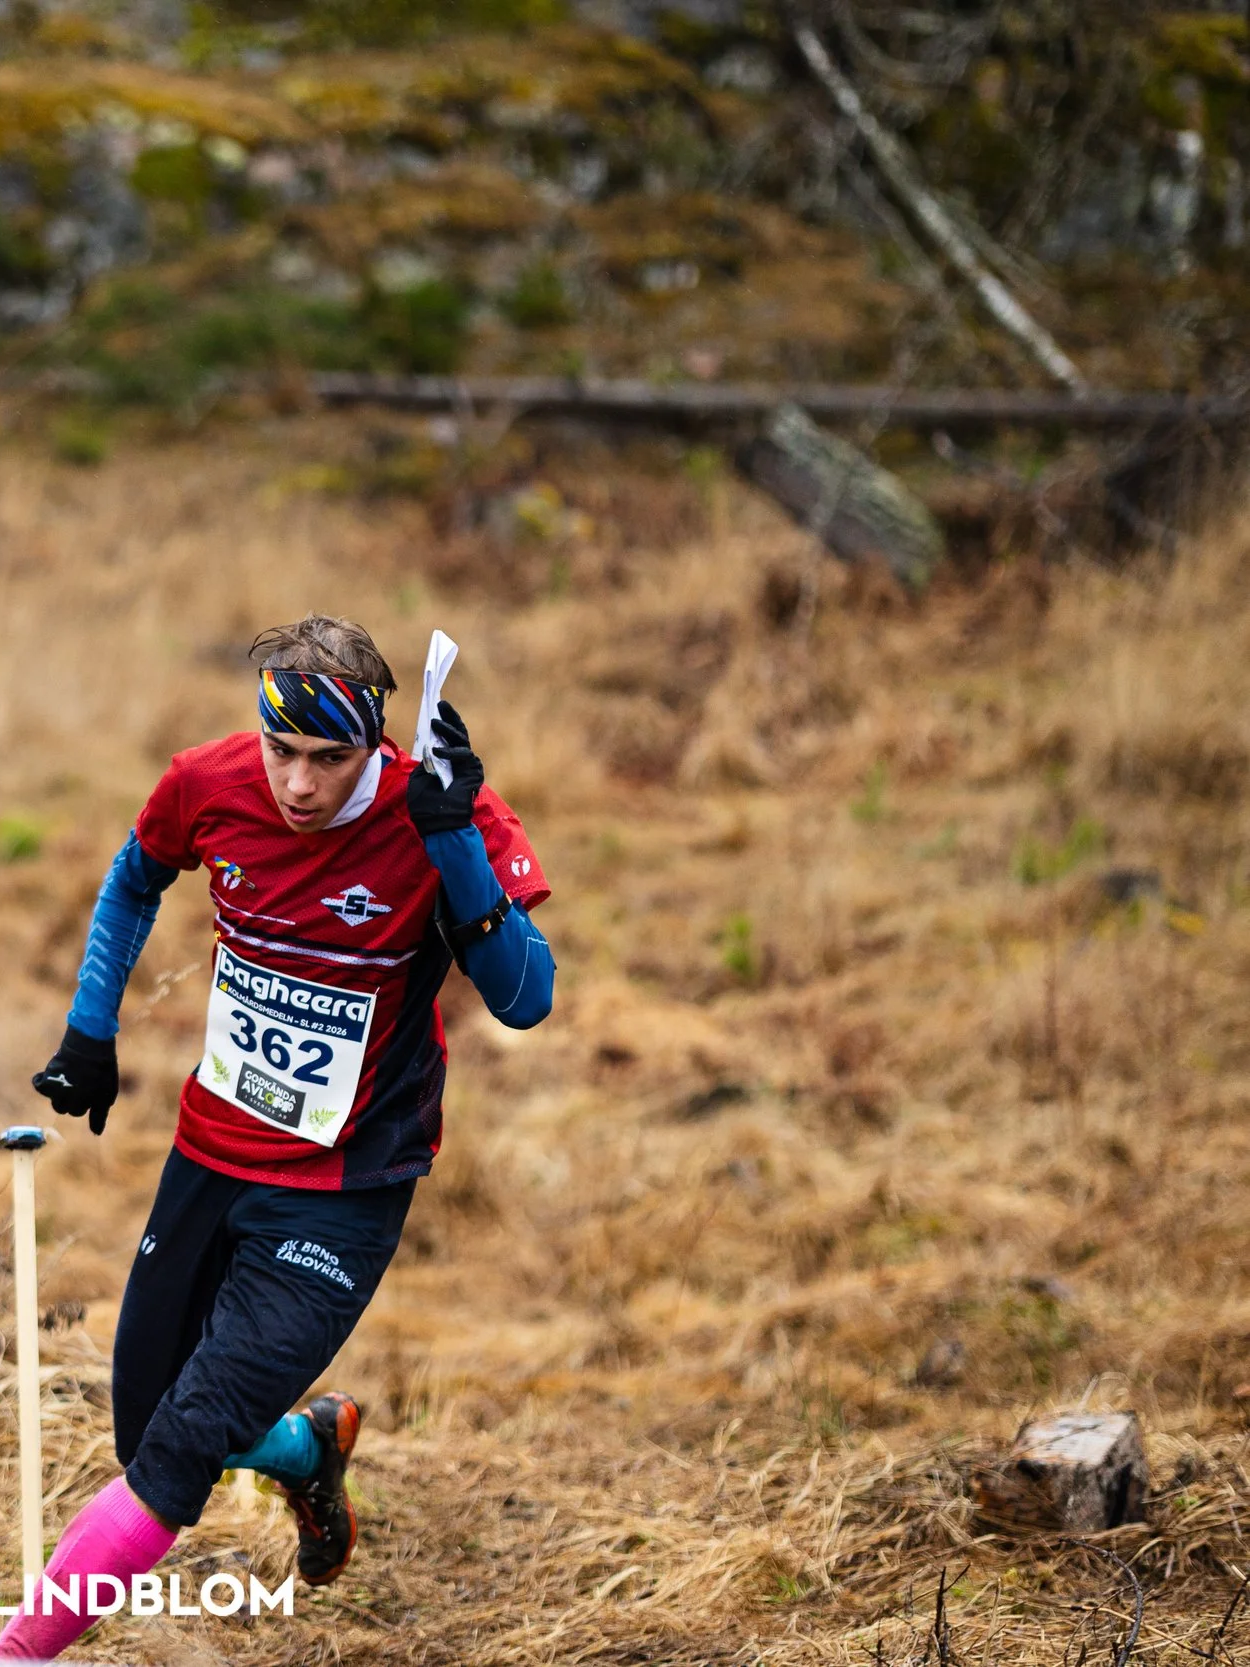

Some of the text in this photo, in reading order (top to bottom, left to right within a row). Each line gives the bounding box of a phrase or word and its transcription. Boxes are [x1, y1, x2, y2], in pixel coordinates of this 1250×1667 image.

[219, 951, 366, 1023] bagheera
[227, 986, 294, 1023] KOLMÅRDSMEDELN
[300, 1018, 310, 1028] SL
[311, 1021, 324, 1030] #2
[325, 1024, 347, 1037] 2026
[229, 1009, 334, 1086] 362
[245, 1070, 297, 1104] GODKÄNDA
[280, 1239, 339, 1266] SK BRNO
